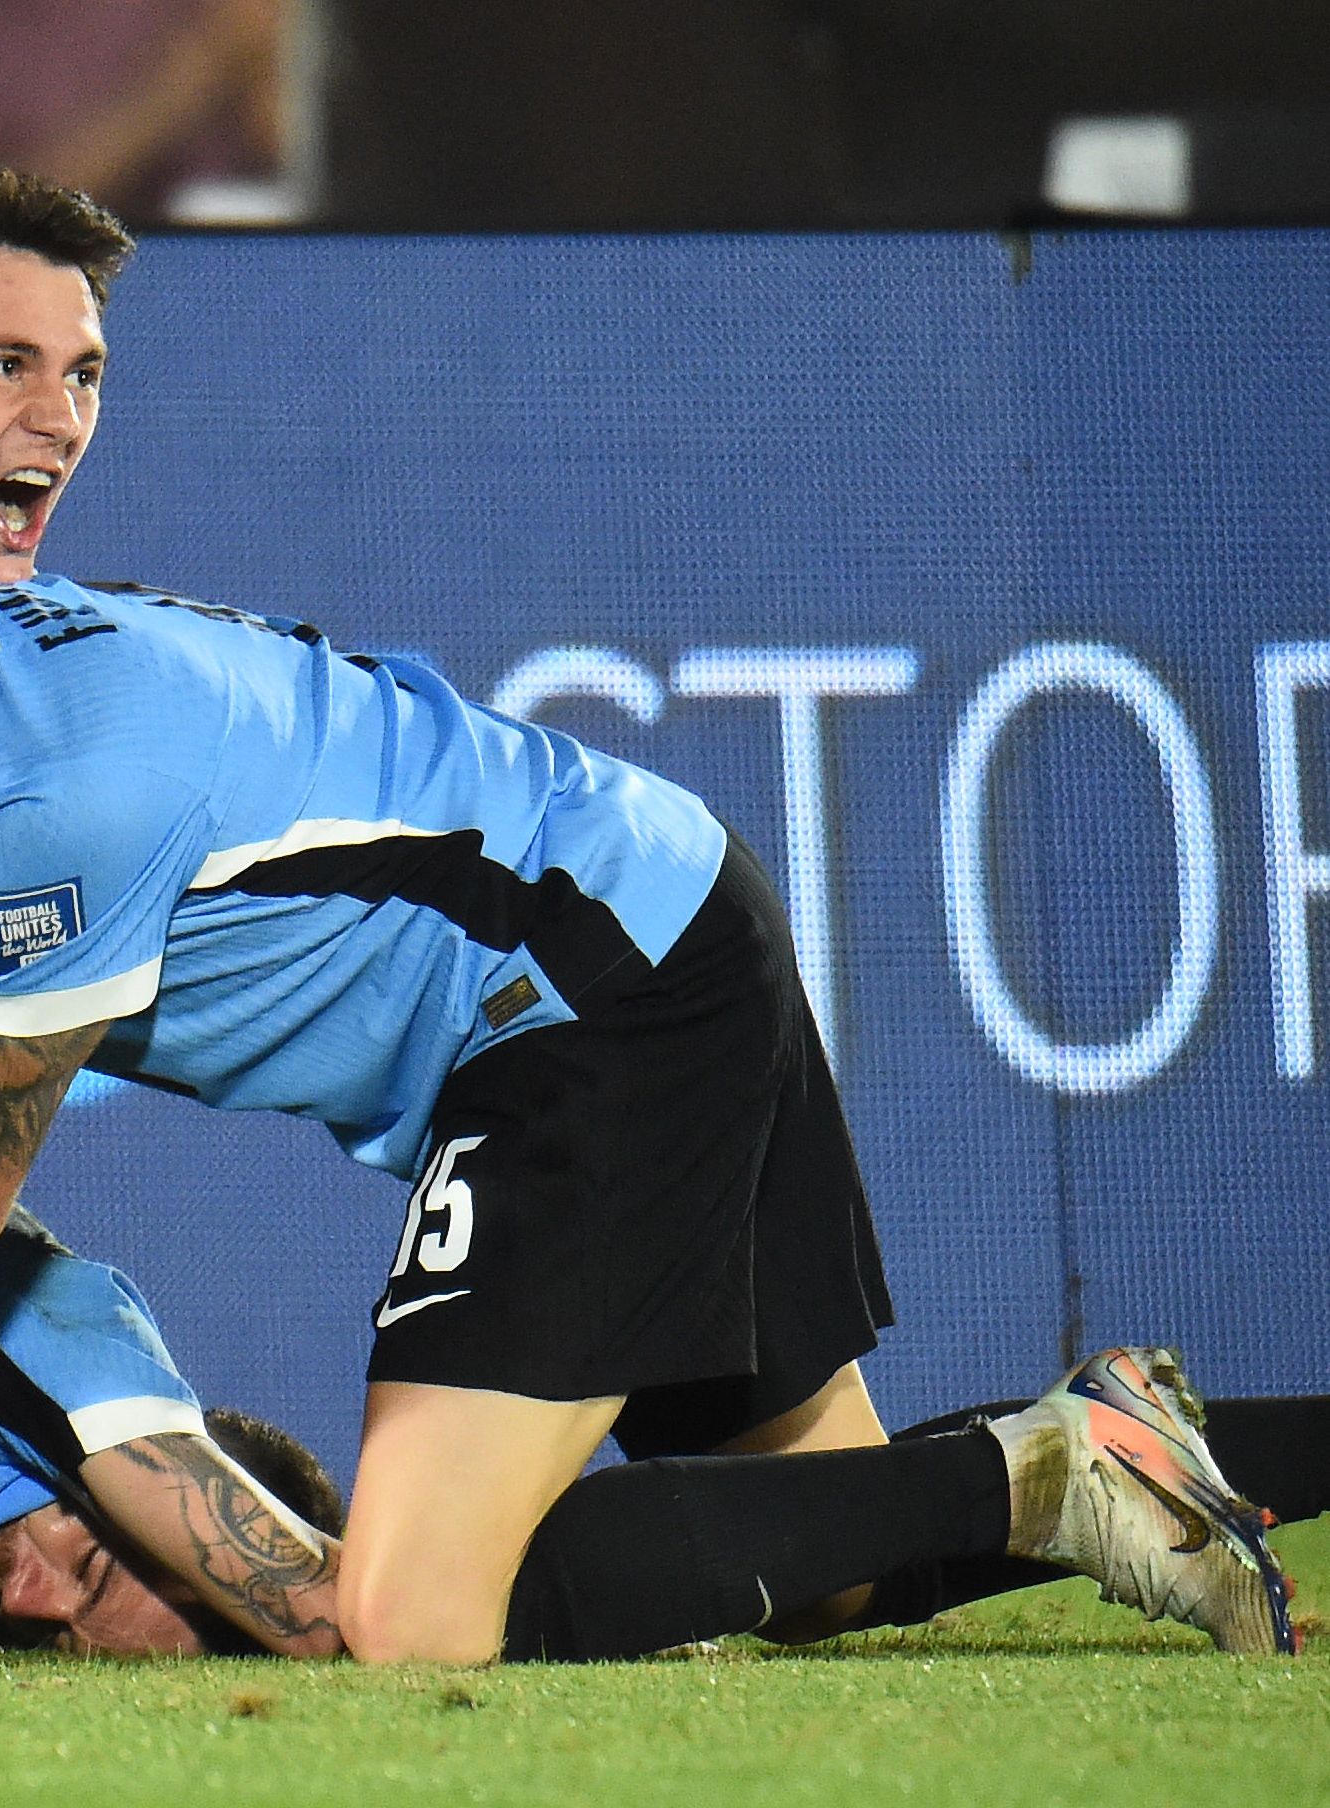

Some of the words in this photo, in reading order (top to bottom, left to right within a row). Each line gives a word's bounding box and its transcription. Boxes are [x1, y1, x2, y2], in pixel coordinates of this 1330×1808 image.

[0, 914, 63, 942] UNITES
[1, 943, 25, 957] the
[25, 930, 67, 950] World
[389, 1134, 489, 1279] 15
